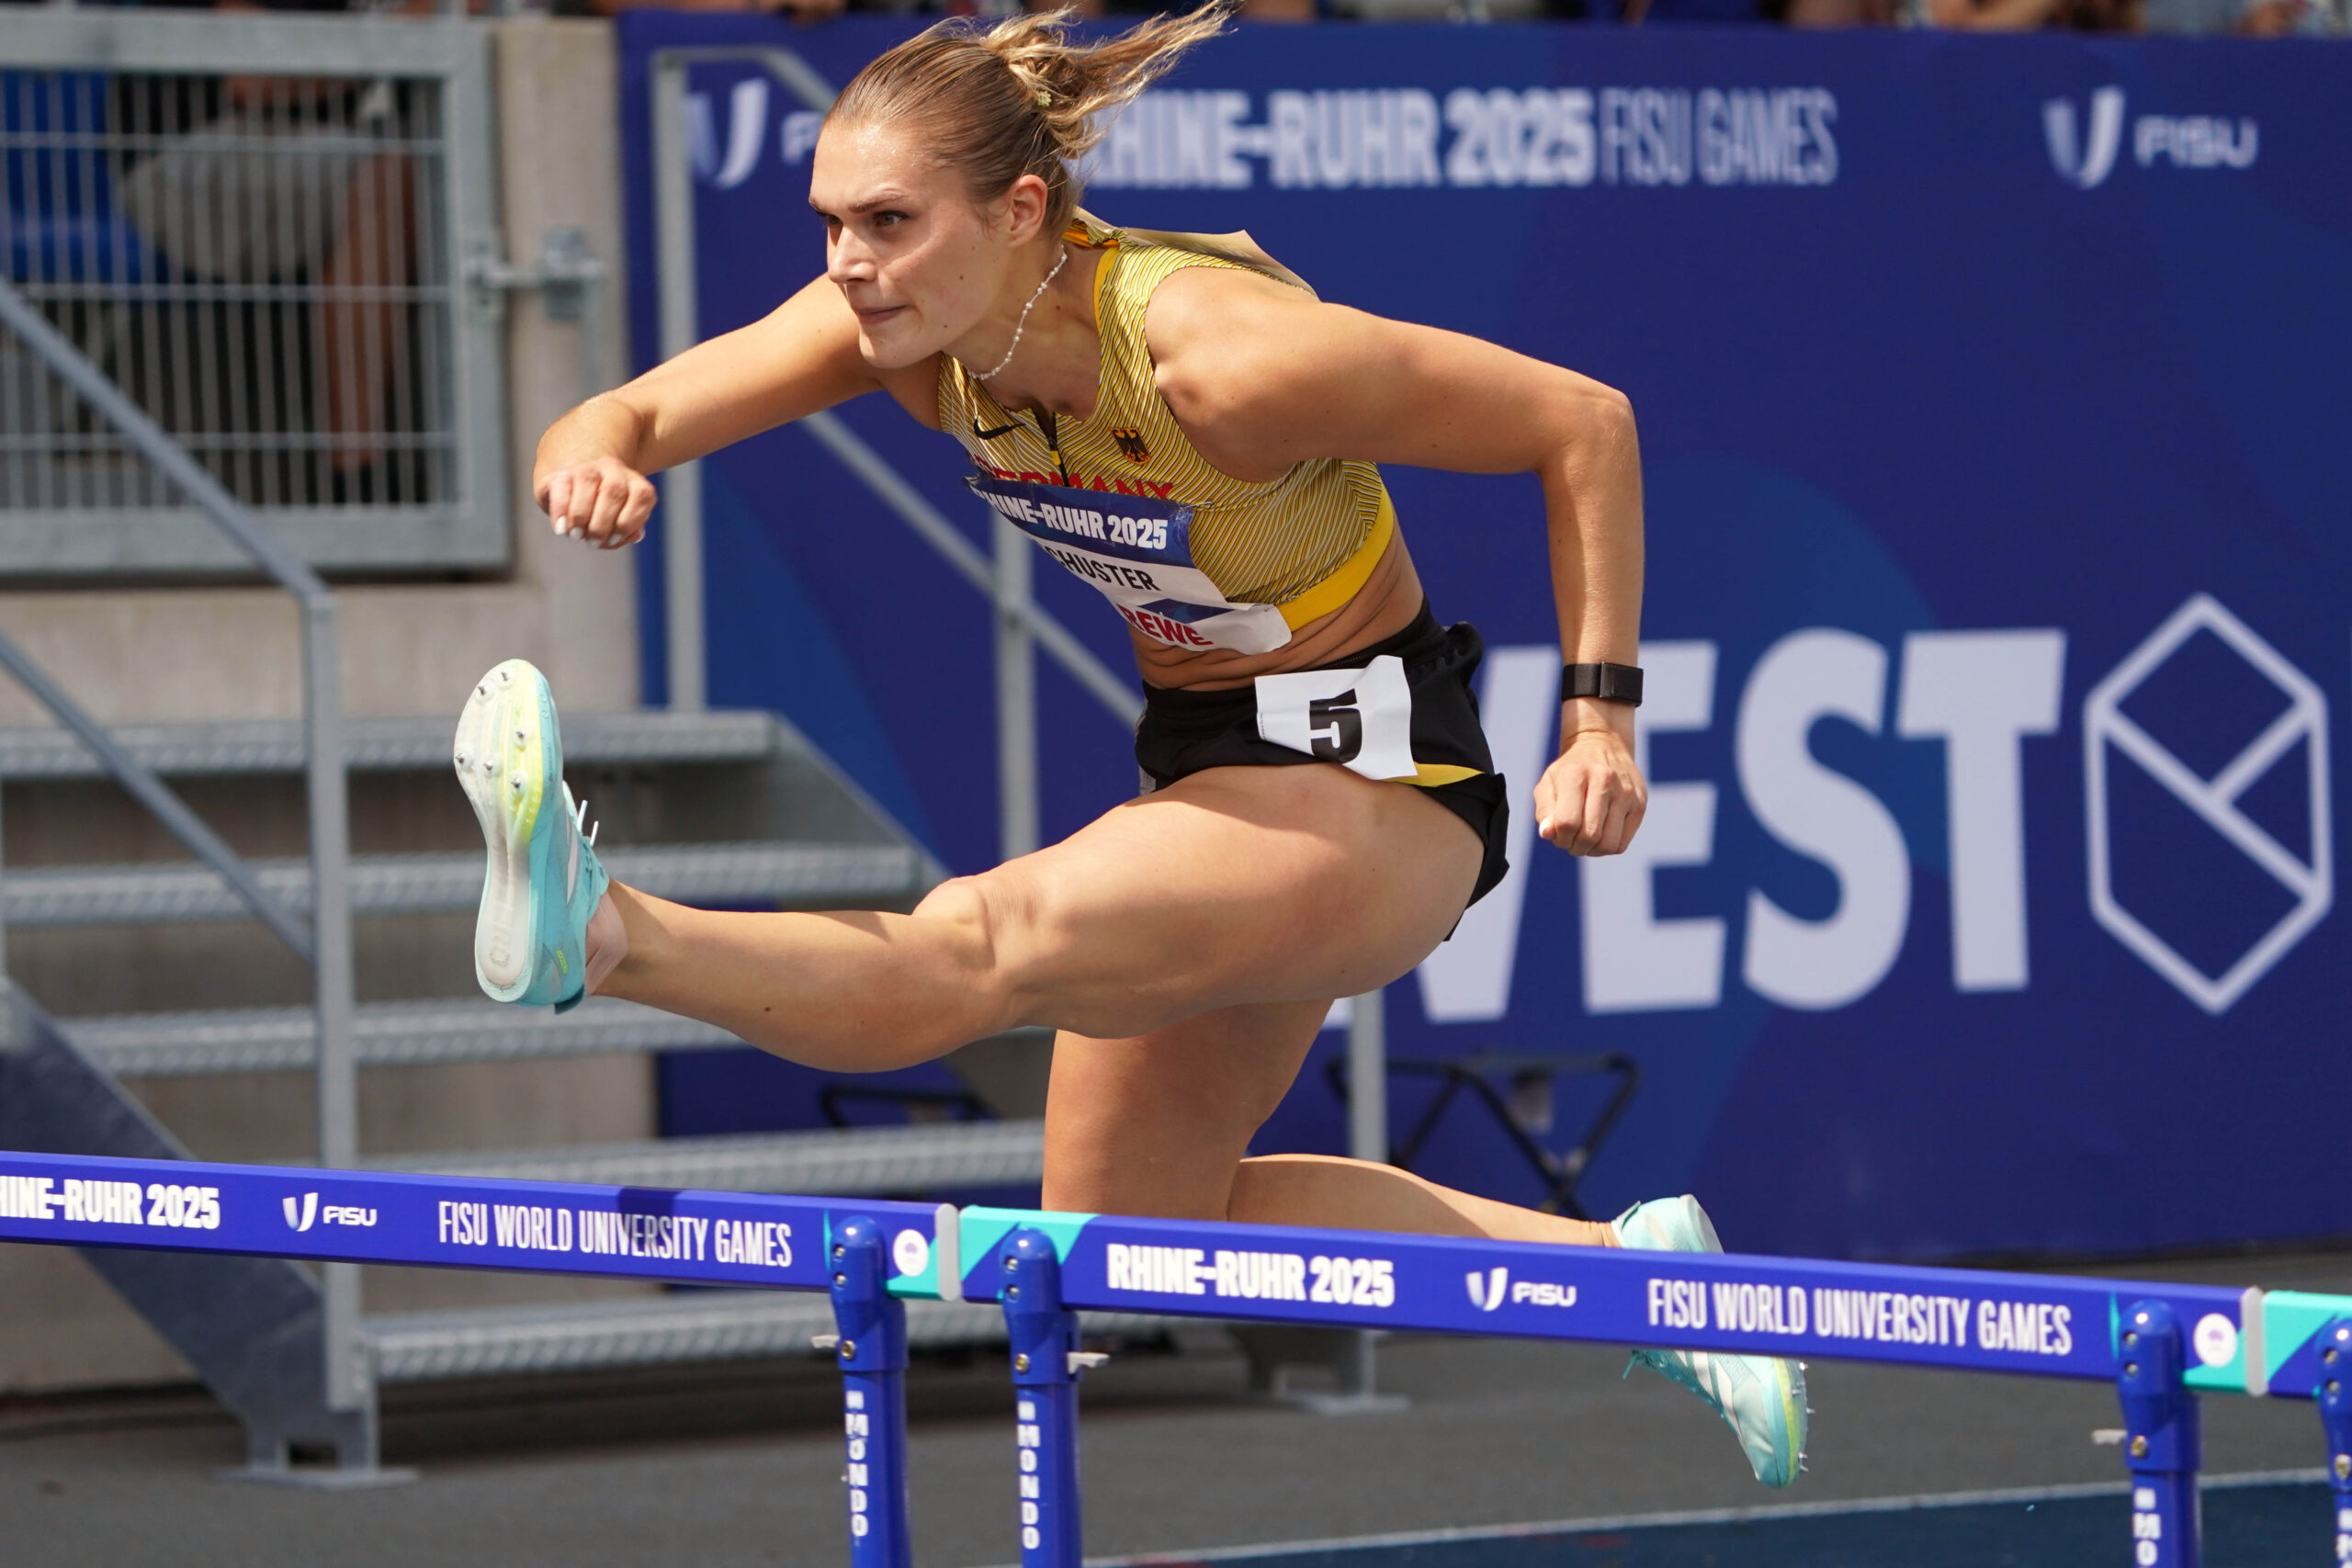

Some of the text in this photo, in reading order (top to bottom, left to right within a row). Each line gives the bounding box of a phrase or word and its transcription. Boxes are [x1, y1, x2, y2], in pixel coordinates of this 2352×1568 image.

[1445, 87, 1597, 186] 2025
[1600, 87, 1691, 185] FISU
[1696, 87, 1837, 185] GAMES
[1107, 514, 1169, 550] 2025
[1116, 603, 1214, 646] REWE
[1309, 687, 1363, 764] 5
[146, 1183, 220, 1230] 2025
[322, 1204, 378, 1227] FISU
[438, 1200, 792, 1268] FISU WORLD UNIVERSITY GAMES
[1106, 1243, 1395, 1308] RHINE-RUHR 2025
[1511, 1280, 1577, 1308] FISU
[1647, 1278, 2073, 1356] FISU WORLD UNIVERSITY GAMES
[845, 1413, 869, 1537] MONDO
[1017, 1424, 1041, 1550] MONDO
